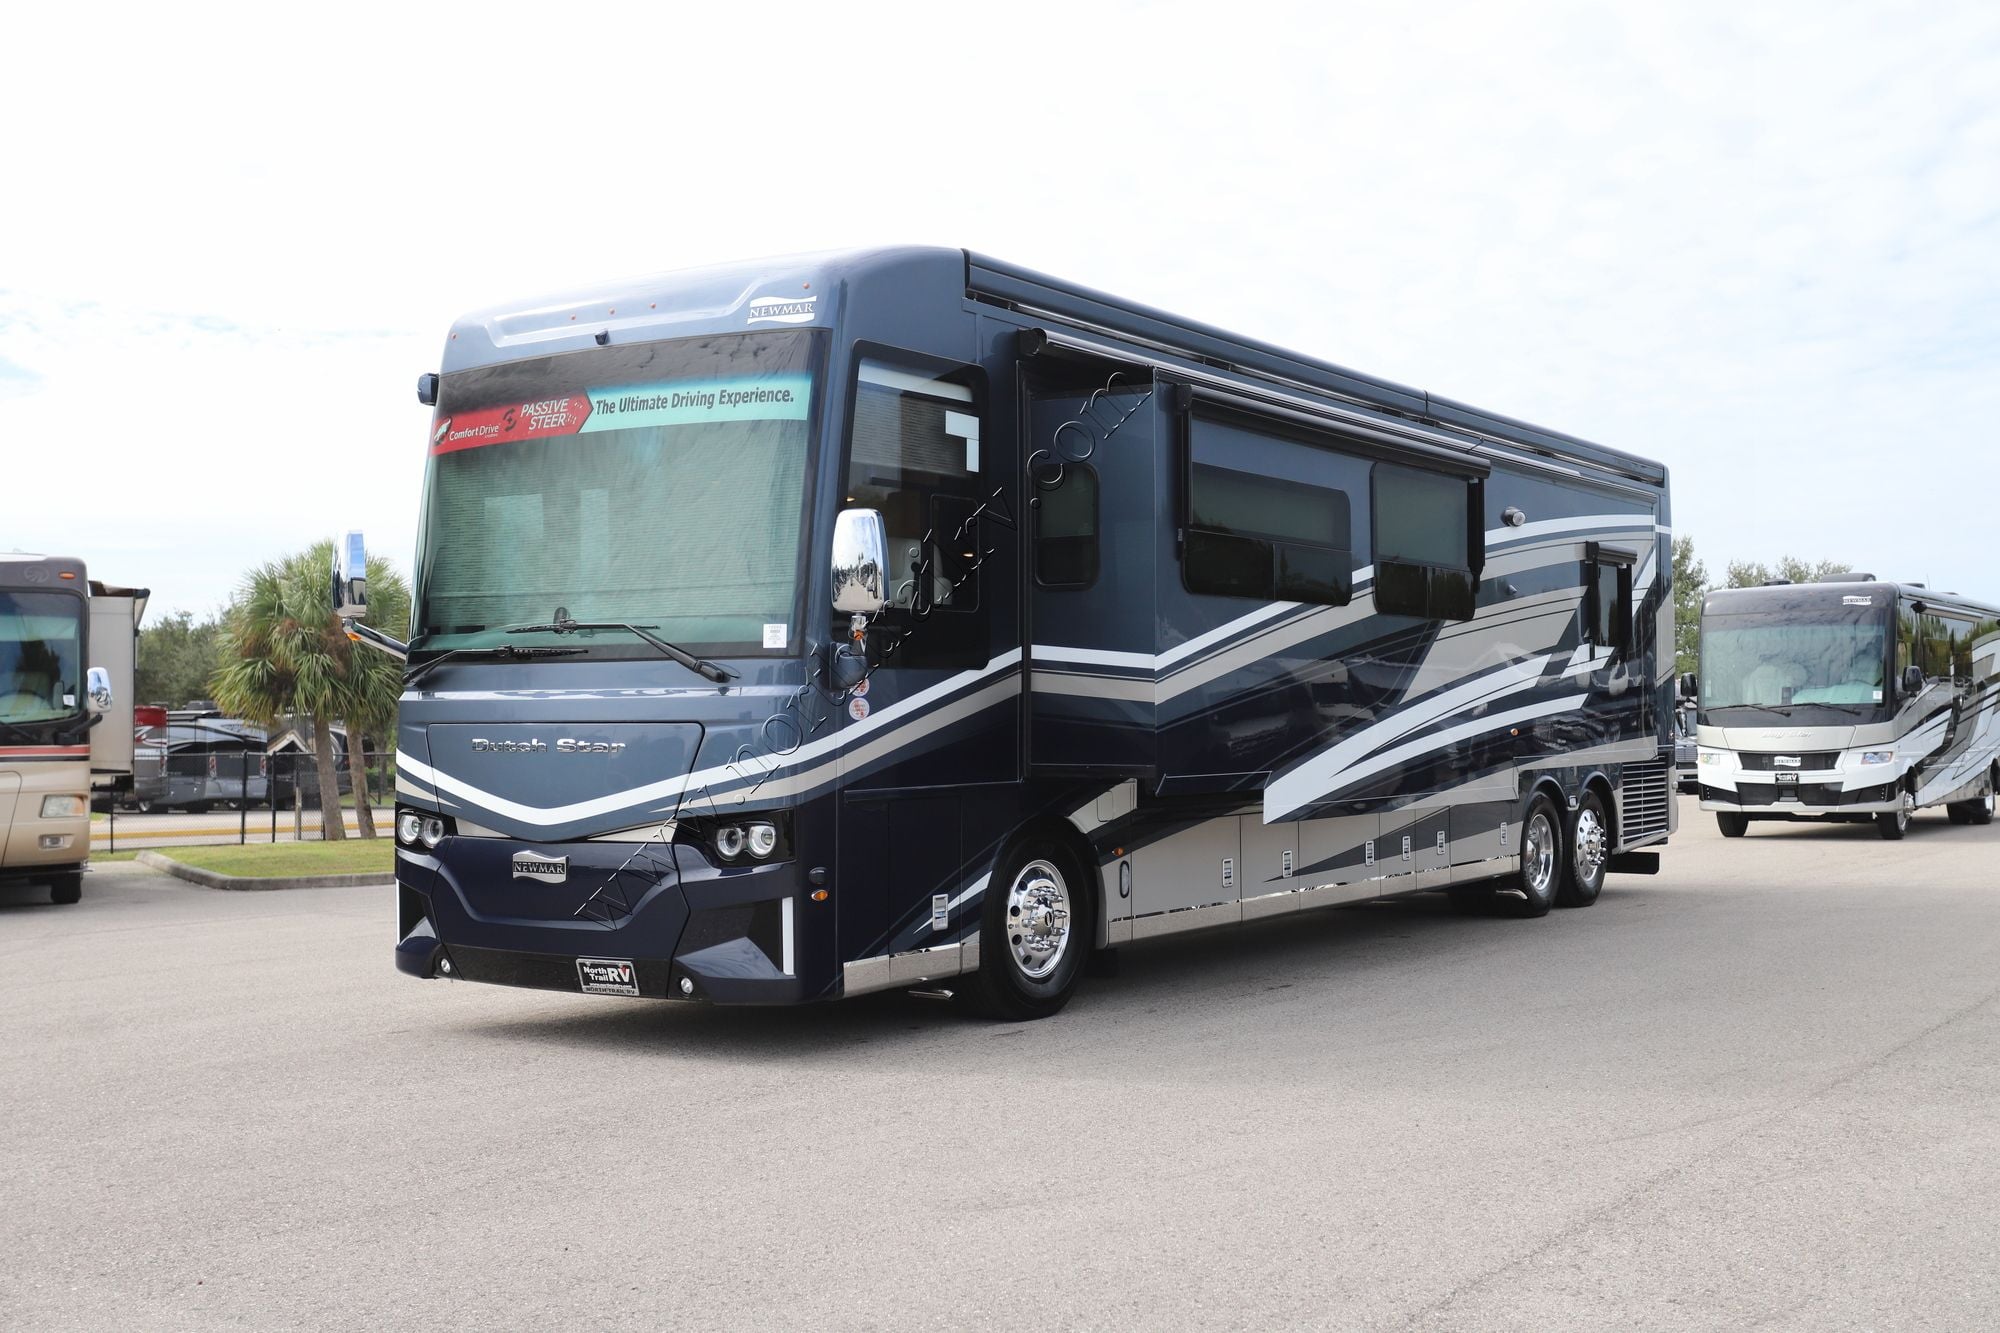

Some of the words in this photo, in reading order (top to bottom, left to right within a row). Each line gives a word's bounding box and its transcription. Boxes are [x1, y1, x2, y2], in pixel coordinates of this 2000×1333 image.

[749, 303, 813, 318] NEWMAR
[520, 398, 570, 418] PASSIVE
[595, 399, 616, 415] The
[619, 395, 668, 413] Ultimate
[671, 391, 715, 410] Driving
[718, 387, 794, 408] Experience.
[528, 413, 567, 431] STEER
[449, 427, 480, 441] Comfort
[478, 423, 500, 436] Drive
[471, 738, 548, 753] Dutch
[556, 738, 626, 753] Star
[514, 862, 565, 874] NEWMAR
[583, 966, 607, 975] North
[606, 967, 630, 983] RV
[588, 973, 609, 982] Trail
